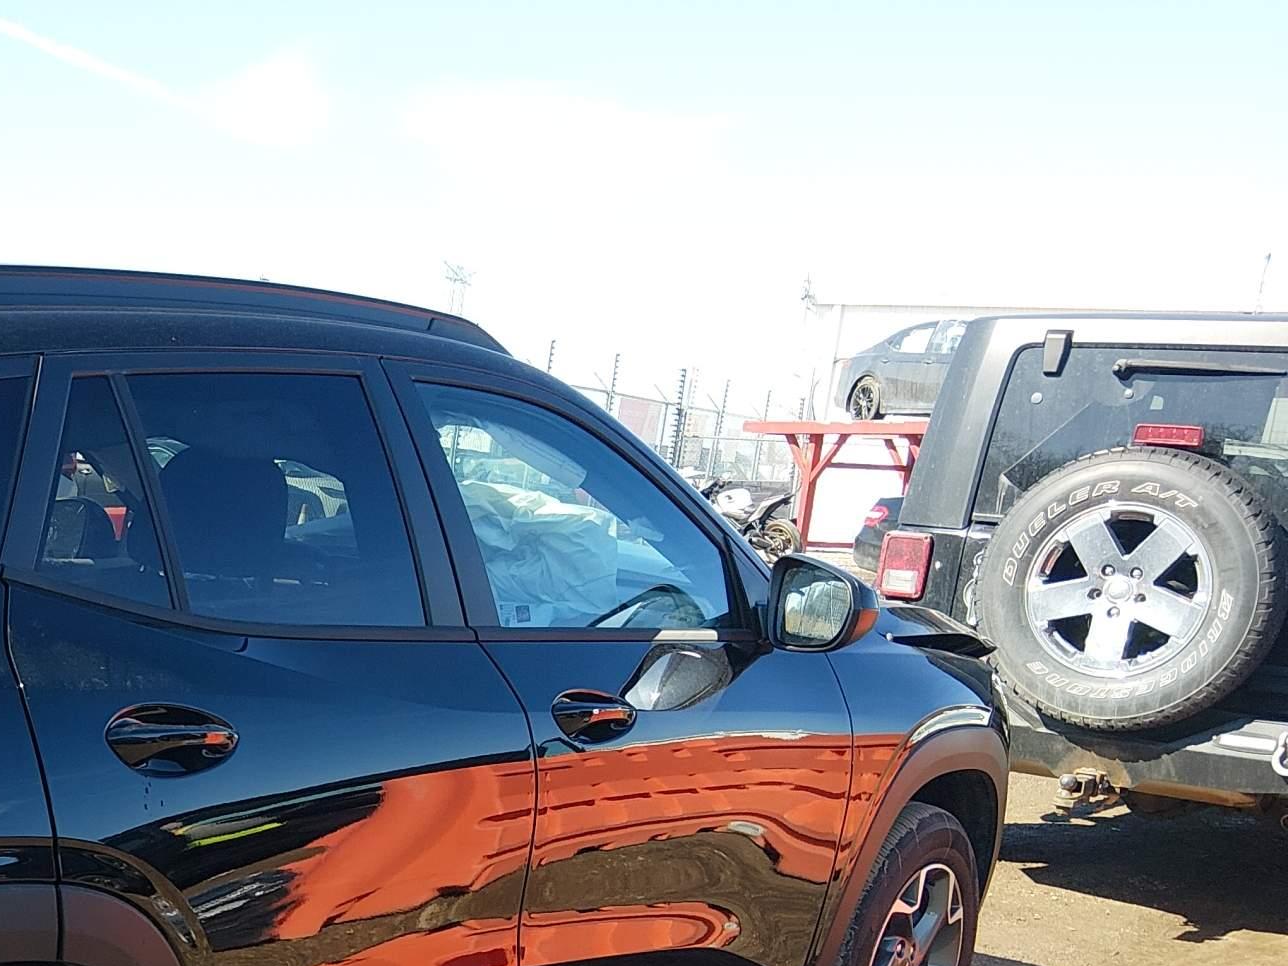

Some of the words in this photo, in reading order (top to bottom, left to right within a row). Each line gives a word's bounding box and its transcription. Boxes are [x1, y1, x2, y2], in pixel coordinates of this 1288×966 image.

[1002, 480, 1121, 586] DUELER
[1131, 482, 1199, 509] A/T
[1025, 588, 1234, 699] BRIDGESTONE
